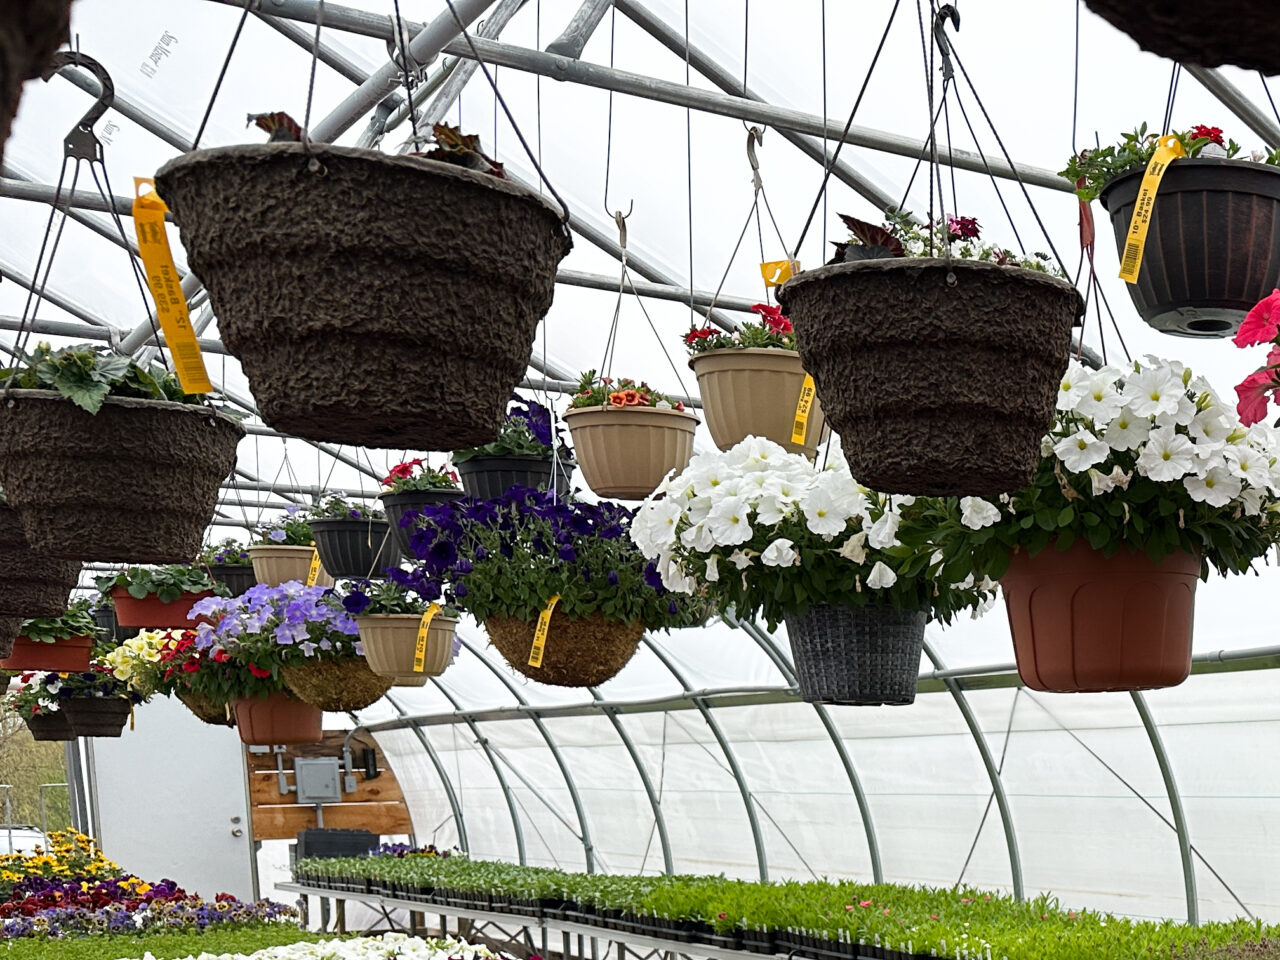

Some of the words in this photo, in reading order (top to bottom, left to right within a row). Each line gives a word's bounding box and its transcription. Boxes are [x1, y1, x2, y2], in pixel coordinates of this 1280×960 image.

[159, 30, 178, 47] Sun
[103, 120, 120, 136] Sun
[1132, 220, 1140, 235] 10"
[1136, 188, 1149, 219] Basket
[1141, 196, 1153, 224] $24.99
[801, 387, 813, 414] $24.99
